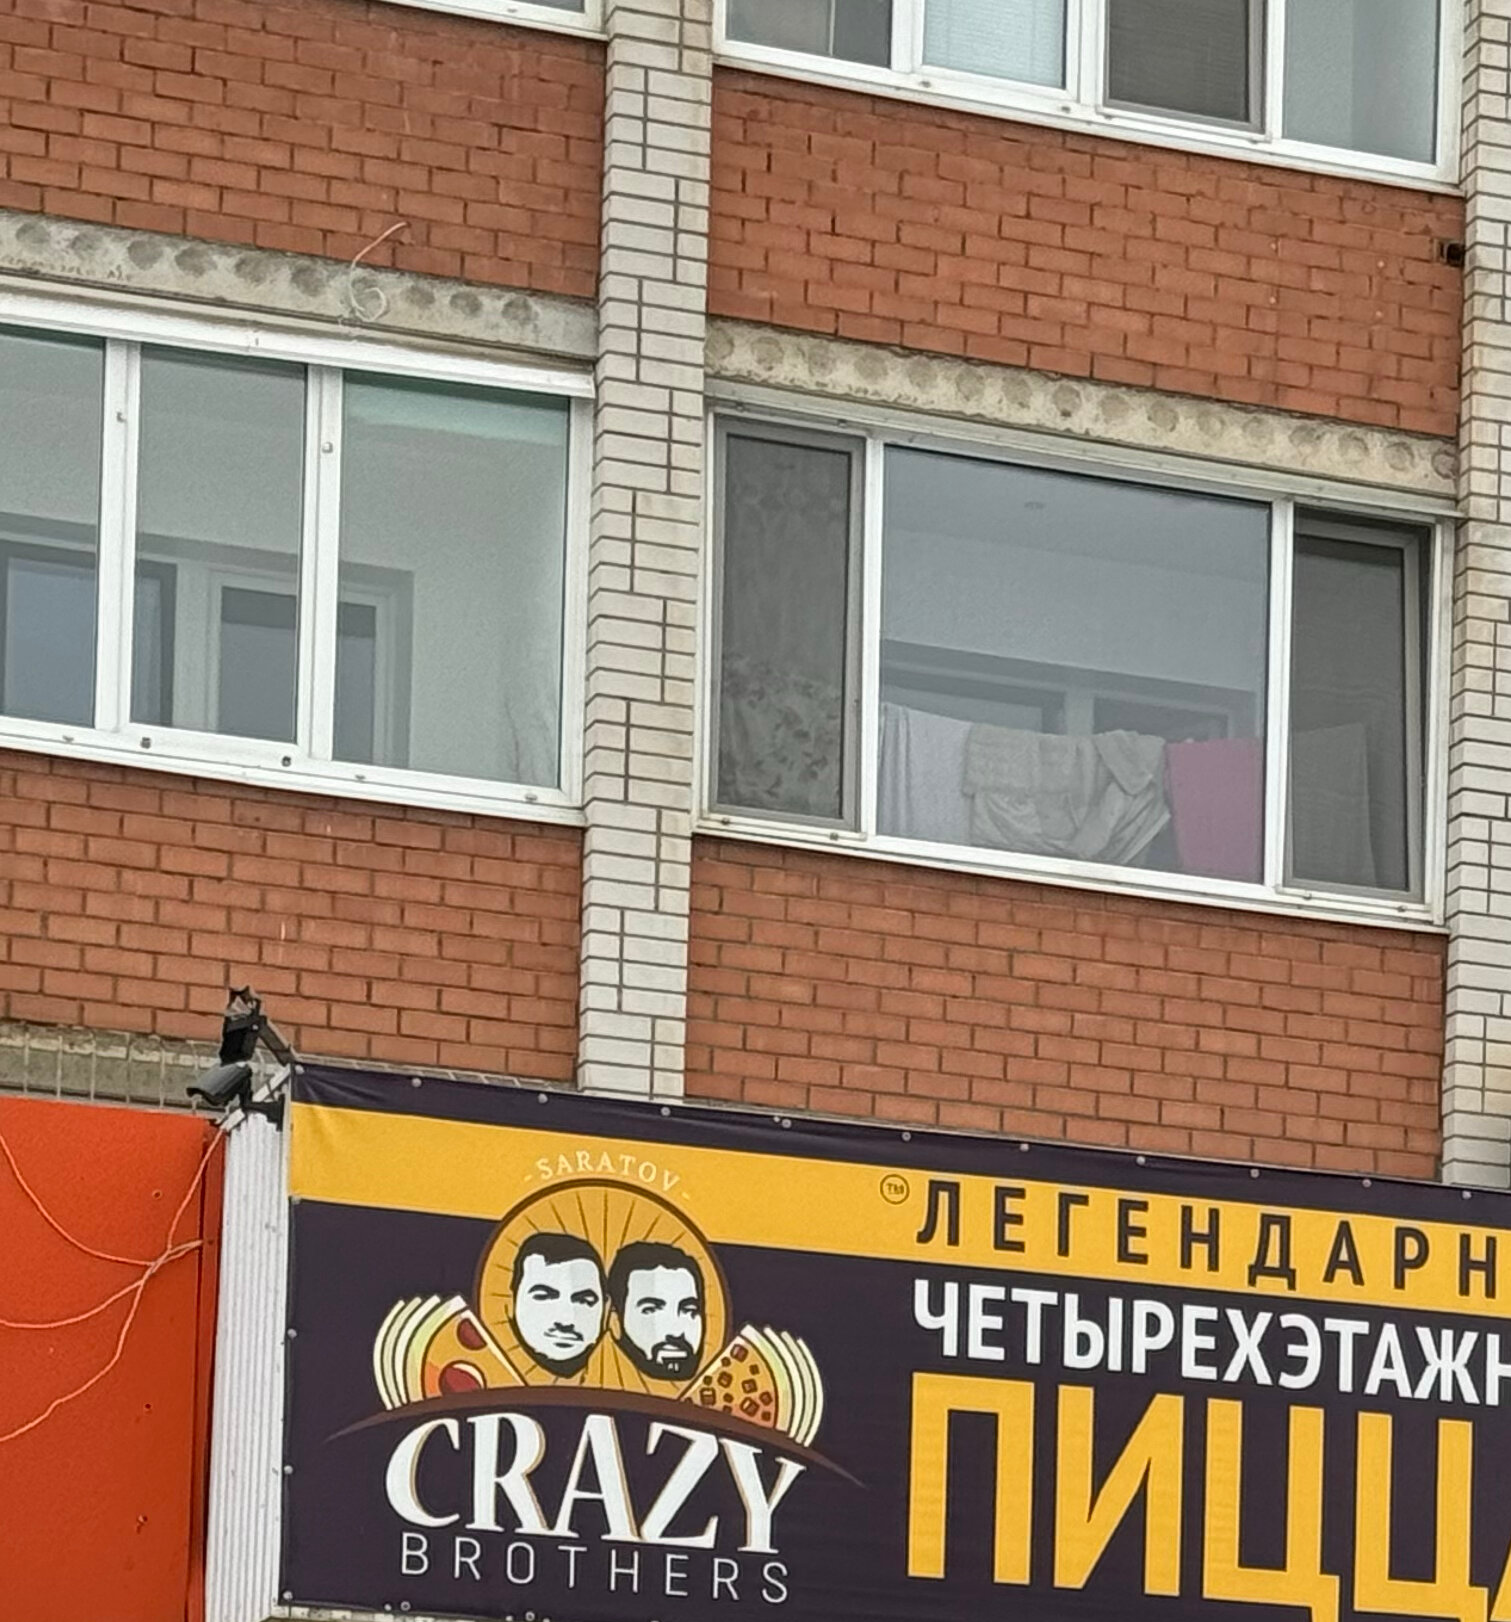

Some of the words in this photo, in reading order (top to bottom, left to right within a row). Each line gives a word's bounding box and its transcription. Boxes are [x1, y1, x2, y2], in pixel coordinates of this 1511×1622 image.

[536, 1150, 680, 1191] SARATOV
[385, 1412, 807, 1554] CRAZY
[401, 1533, 789, 1603] BROTHERS
